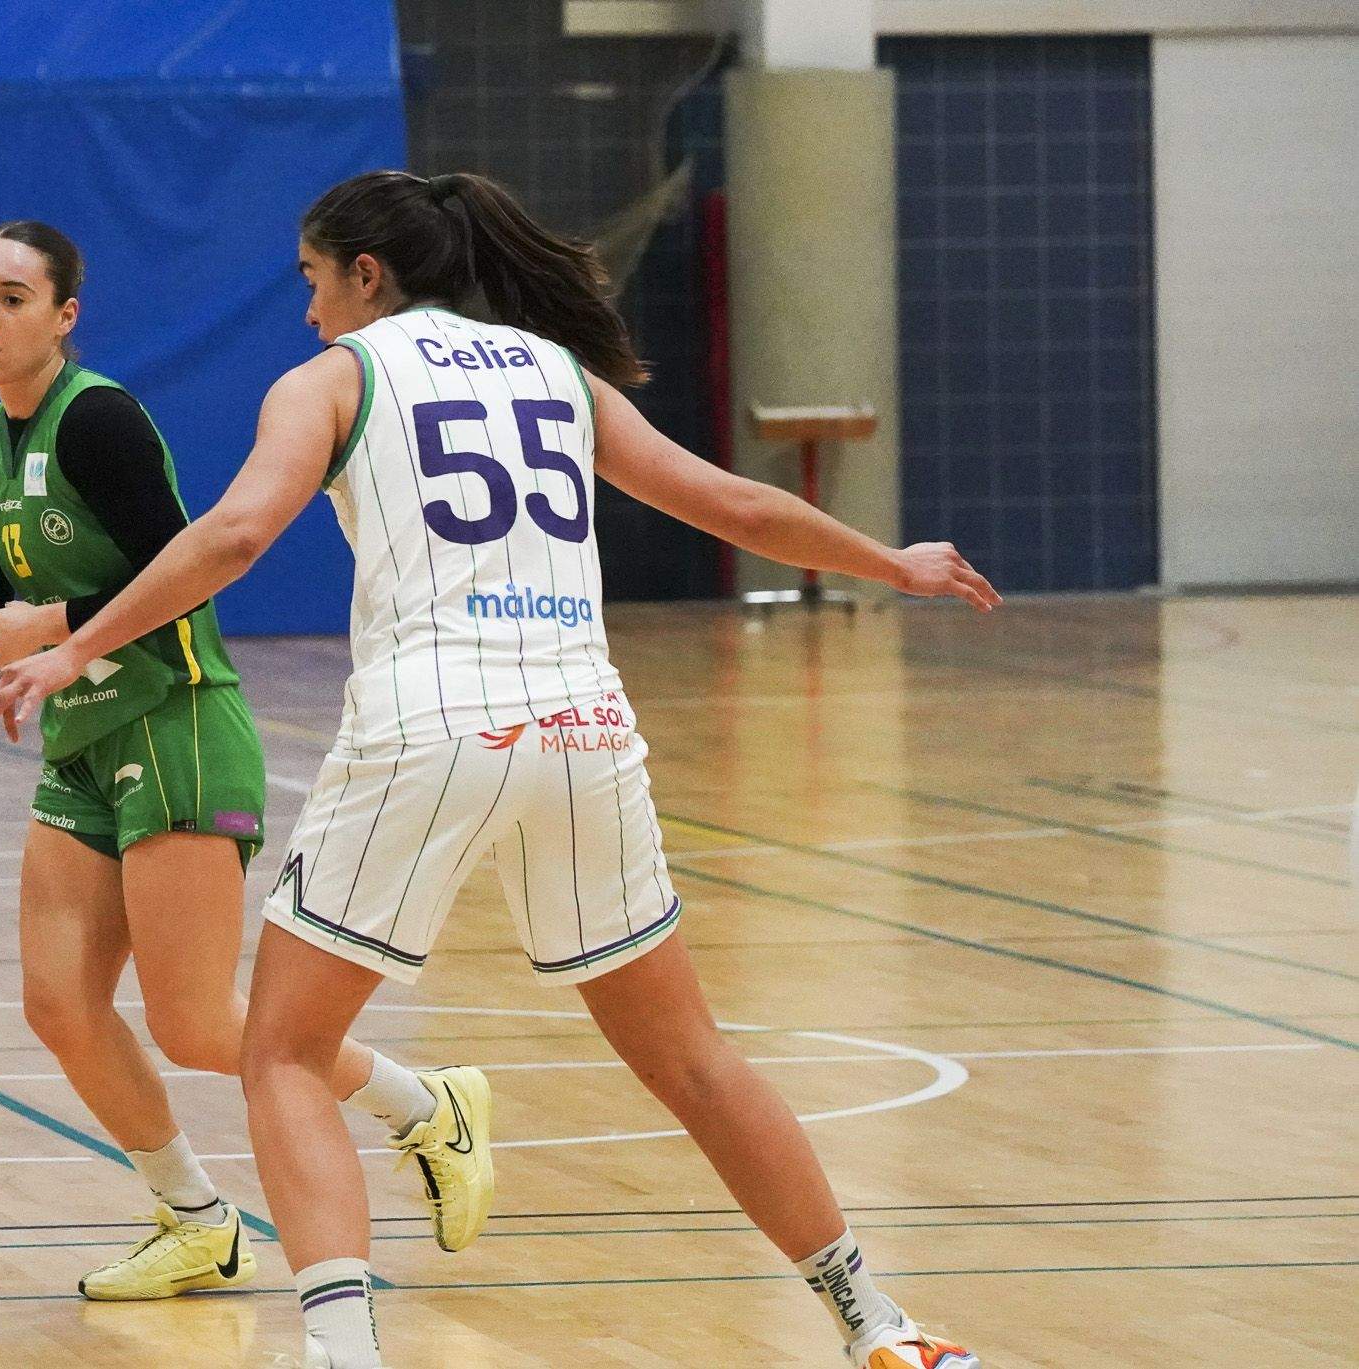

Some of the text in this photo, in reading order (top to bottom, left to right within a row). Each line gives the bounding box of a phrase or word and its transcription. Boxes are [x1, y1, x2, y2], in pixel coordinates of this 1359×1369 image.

[416, 338, 535, 371] Celia
[412, 399, 589, 545] 55
[1, 523, 31, 578] 13
[467, 583, 592, 627] málaga
[593, 706, 630, 728] SOL
[821, 1263, 865, 1332] UNICAJA
